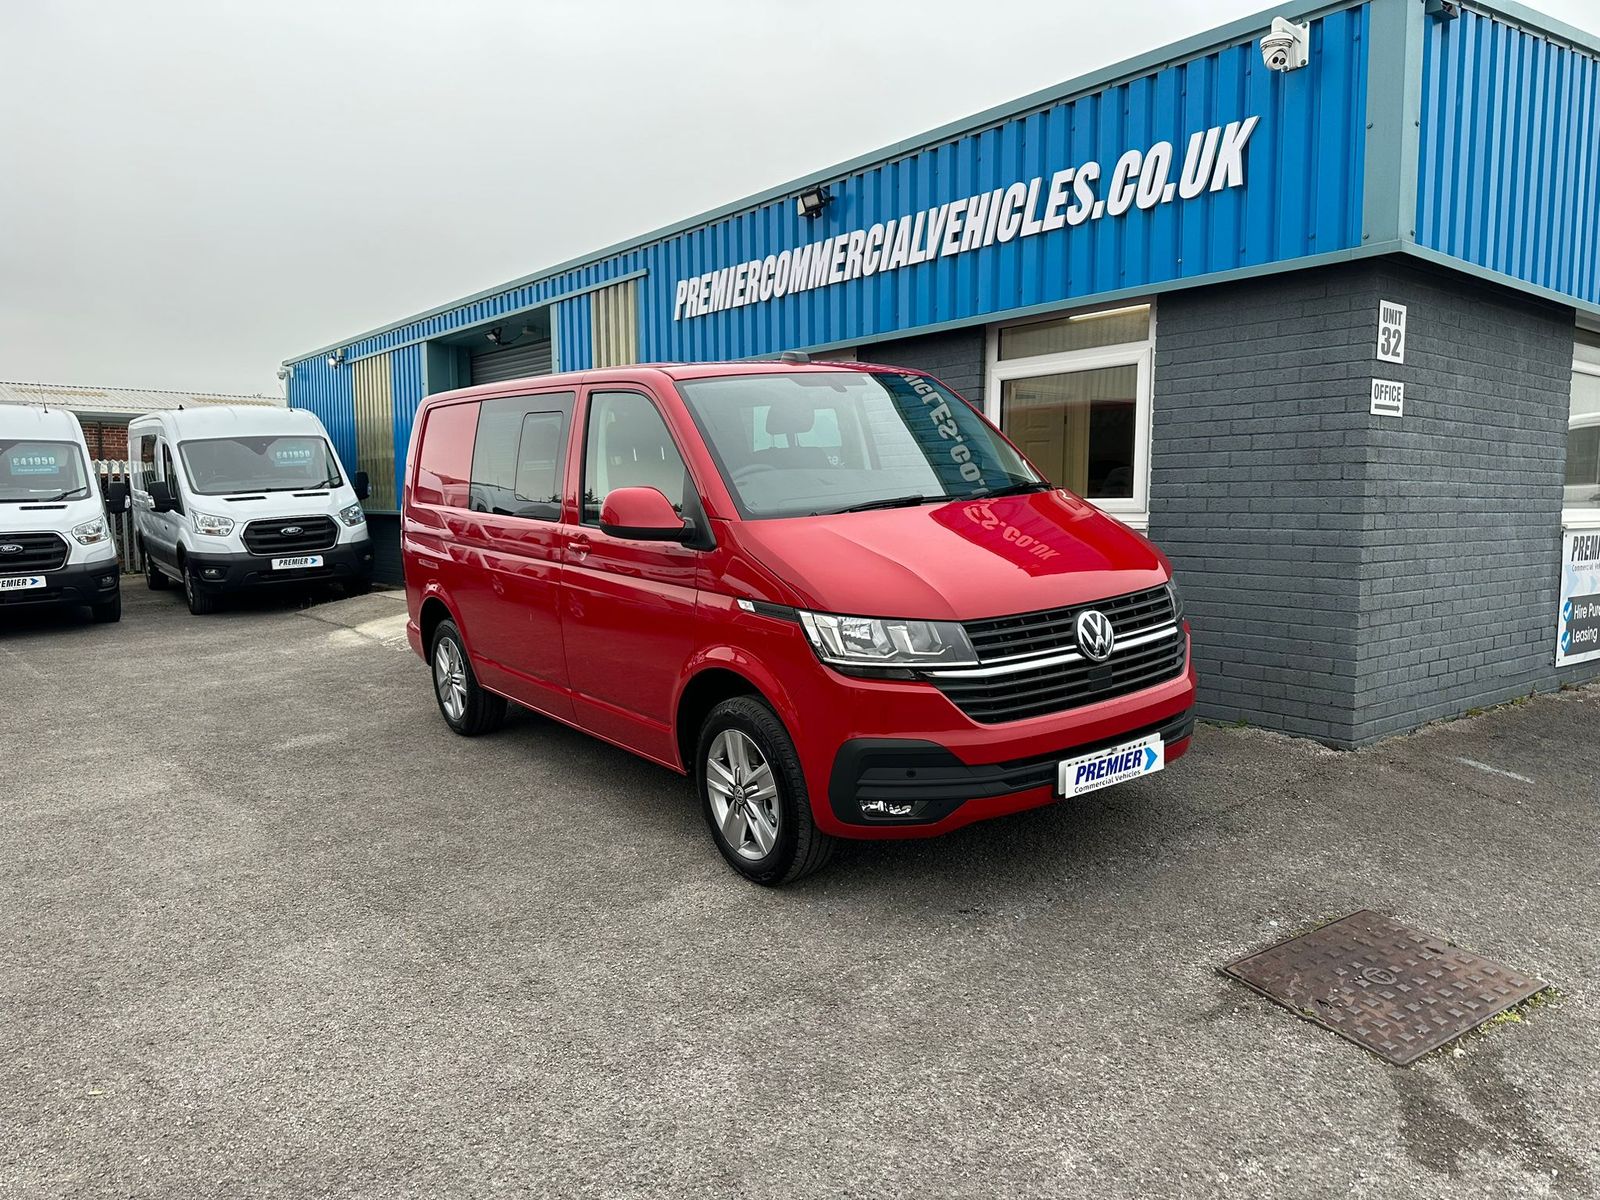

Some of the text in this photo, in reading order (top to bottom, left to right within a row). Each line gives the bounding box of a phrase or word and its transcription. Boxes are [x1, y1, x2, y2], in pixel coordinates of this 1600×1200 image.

[674, 115, 1259, 320] PREMIERCOMMERCIALVEHICLES.CO.UK
[1382, 307, 1403, 326] UNIT
[1380, 326, 1402, 358] 32
[1374, 383, 1402, 402] OFFICE
[13, 456, 56, 466] £41950
[1571, 535, 1600, 561] PREM
[278, 557, 309, 567] PREMIER
[0, 578, 27, 588] EMIER
[1573, 604, 1588, 620] Hire
[1572, 626, 1599, 644] Leasing
[1074, 748, 1143, 786] PREMIER
[1074, 769, 1141, 794] Commercial Vehicles
